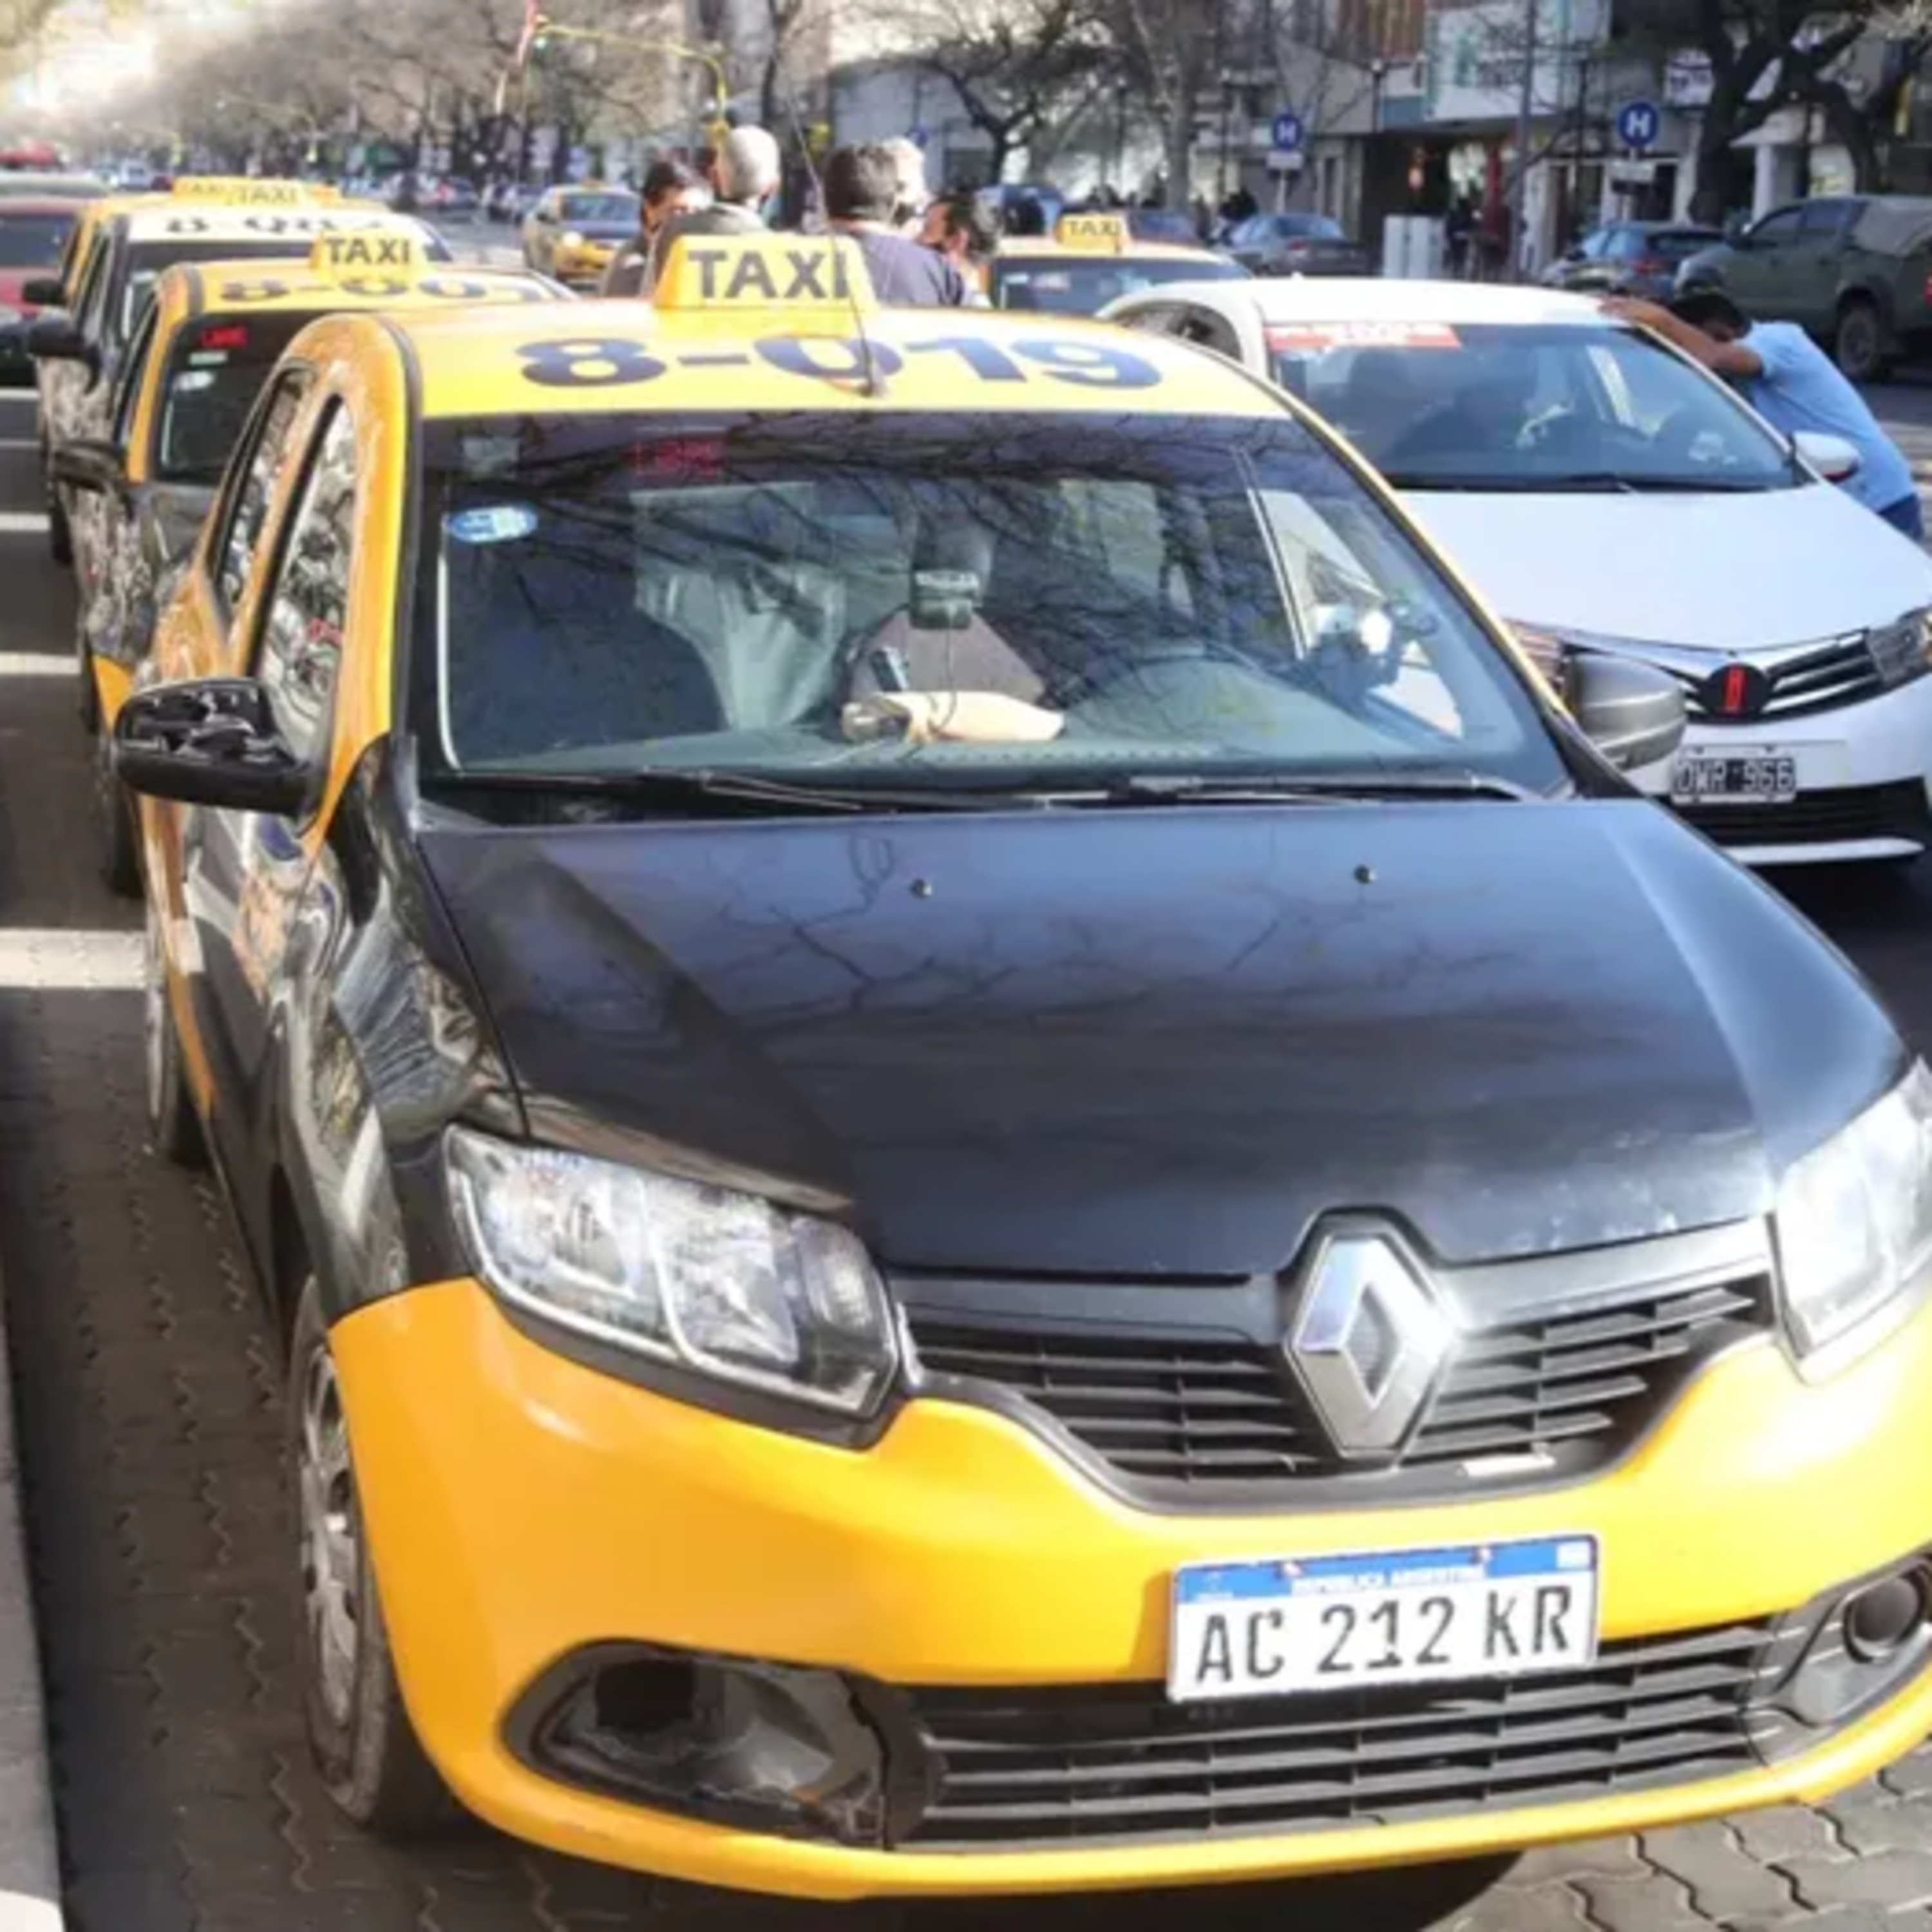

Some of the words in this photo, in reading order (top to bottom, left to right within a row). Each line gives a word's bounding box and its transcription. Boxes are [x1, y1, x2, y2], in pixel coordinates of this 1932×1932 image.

[1626, 109, 1651, 137] H
[234, 185, 297, 204] TAXI
[1065, 220, 1121, 236] TAXI
[326, 238, 411, 265] TAXI
[687, 250, 849, 299] TAXI
[516, 337, 1162, 388] 8-019
[1196, 1609, 1285, 1683] AC
[1316, 1596, 1457, 1674] 212
[1482, 1586, 1573, 1660] KR
